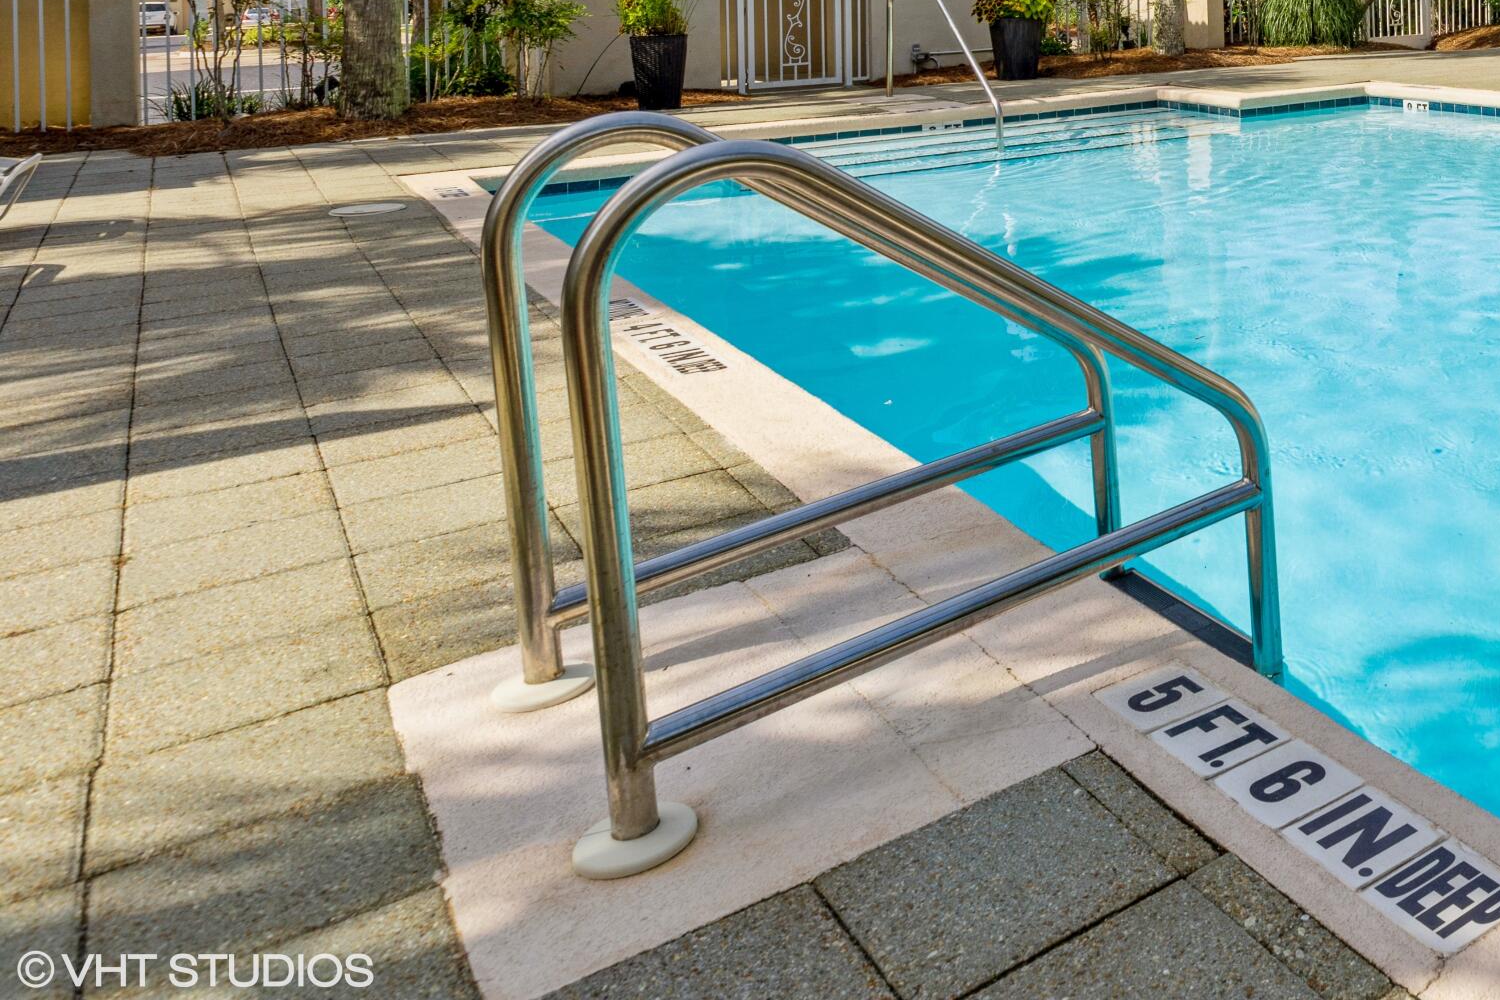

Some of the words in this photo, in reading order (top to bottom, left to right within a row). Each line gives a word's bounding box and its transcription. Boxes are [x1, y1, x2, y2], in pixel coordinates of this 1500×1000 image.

[623, 322, 664, 332] 4
[1127, 675, 1205, 713] 5
[1164, 704, 1279, 768] FT.
[1249, 760, 1326, 803] 6
[1298, 793, 1417, 877] IN.
